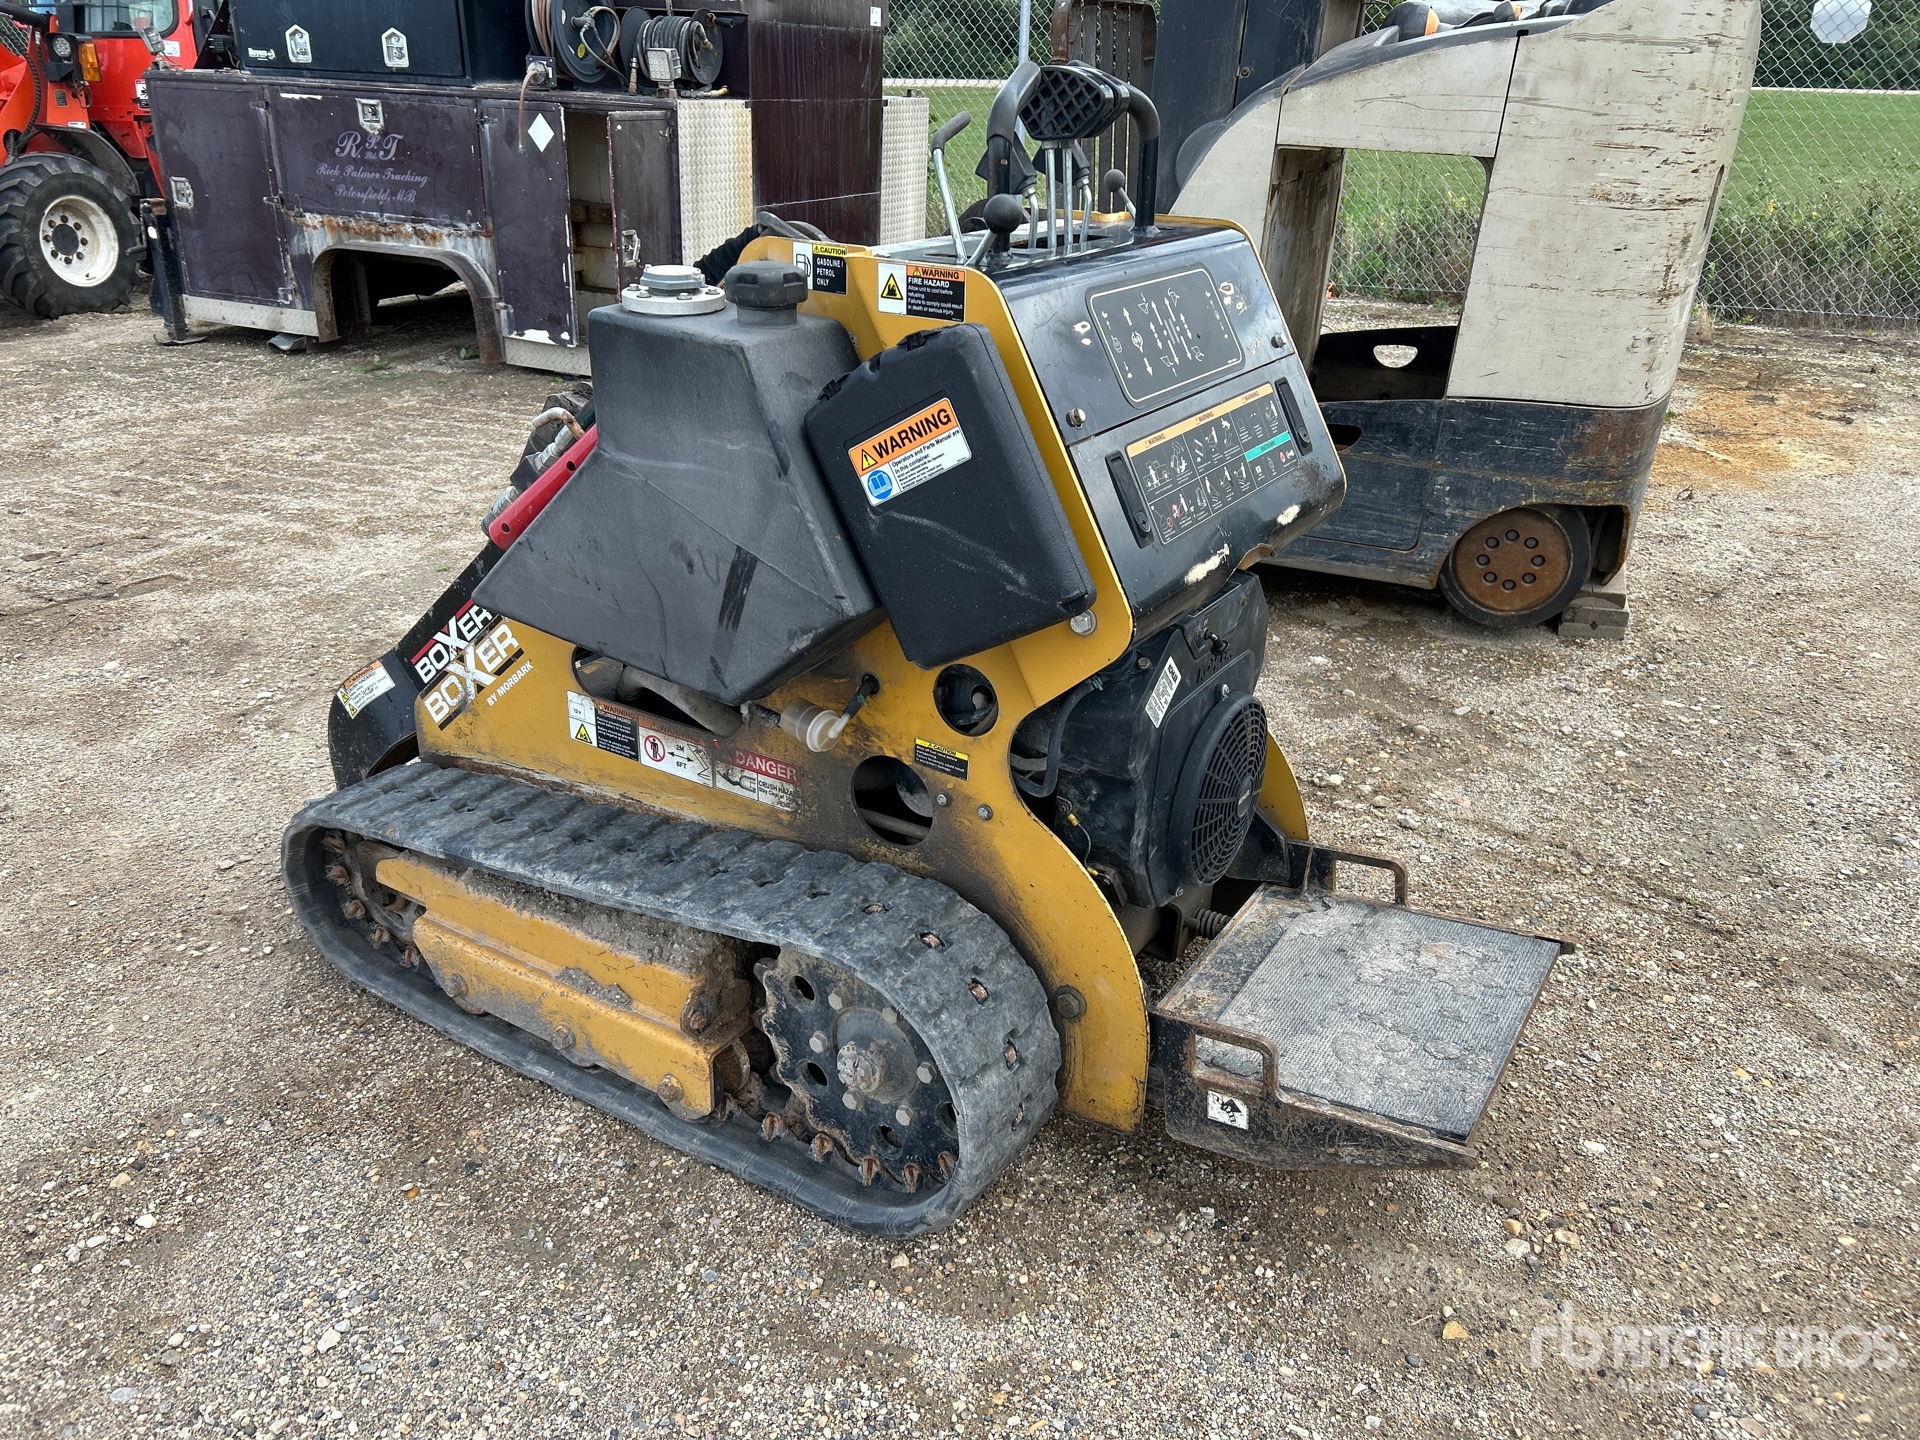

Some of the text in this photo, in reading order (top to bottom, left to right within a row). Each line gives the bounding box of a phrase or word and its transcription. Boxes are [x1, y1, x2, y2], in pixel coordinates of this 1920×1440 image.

[316, 163, 430, 187] Rick Palmer Trucking
[820, 246, 846, 255] CAUTION
[816, 258, 839, 266] GASOLINE
[816, 268, 835, 277] PETROL
[922, 268, 959, 279] WARNING
[816, 278, 829, 286] ONLY
[924, 279, 950, 287] HAZARD
[1244, 391, 1260, 403] WARNING
[1199, 411, 1214, 424] WARNING
[872, 408, 952, 459] WARNING
[1148, 433, 1166, 446] WARNING
[892, 453, 914, 467] Operators
[914, 448, 922, 458] and
[924, 443, 935, 451] Parts
[935, 433, 952, 446] Manual
[414, 605, 493, 684] BOXER
[352, 666, 373, 682] WARNING
[424, 624, 519, 724] BOXER
[487, 661, 534, 706] BY MORBARK
[603, 704, 635, 719] WARNING
[676, 744, 684, 752] 2M
[934, 744, 956, 756] CAUTION
[676, 761, 687, 769] 6FT
[736, 751, 797, 782] DANGER
[759, 781, 777, 792] CRUSH
